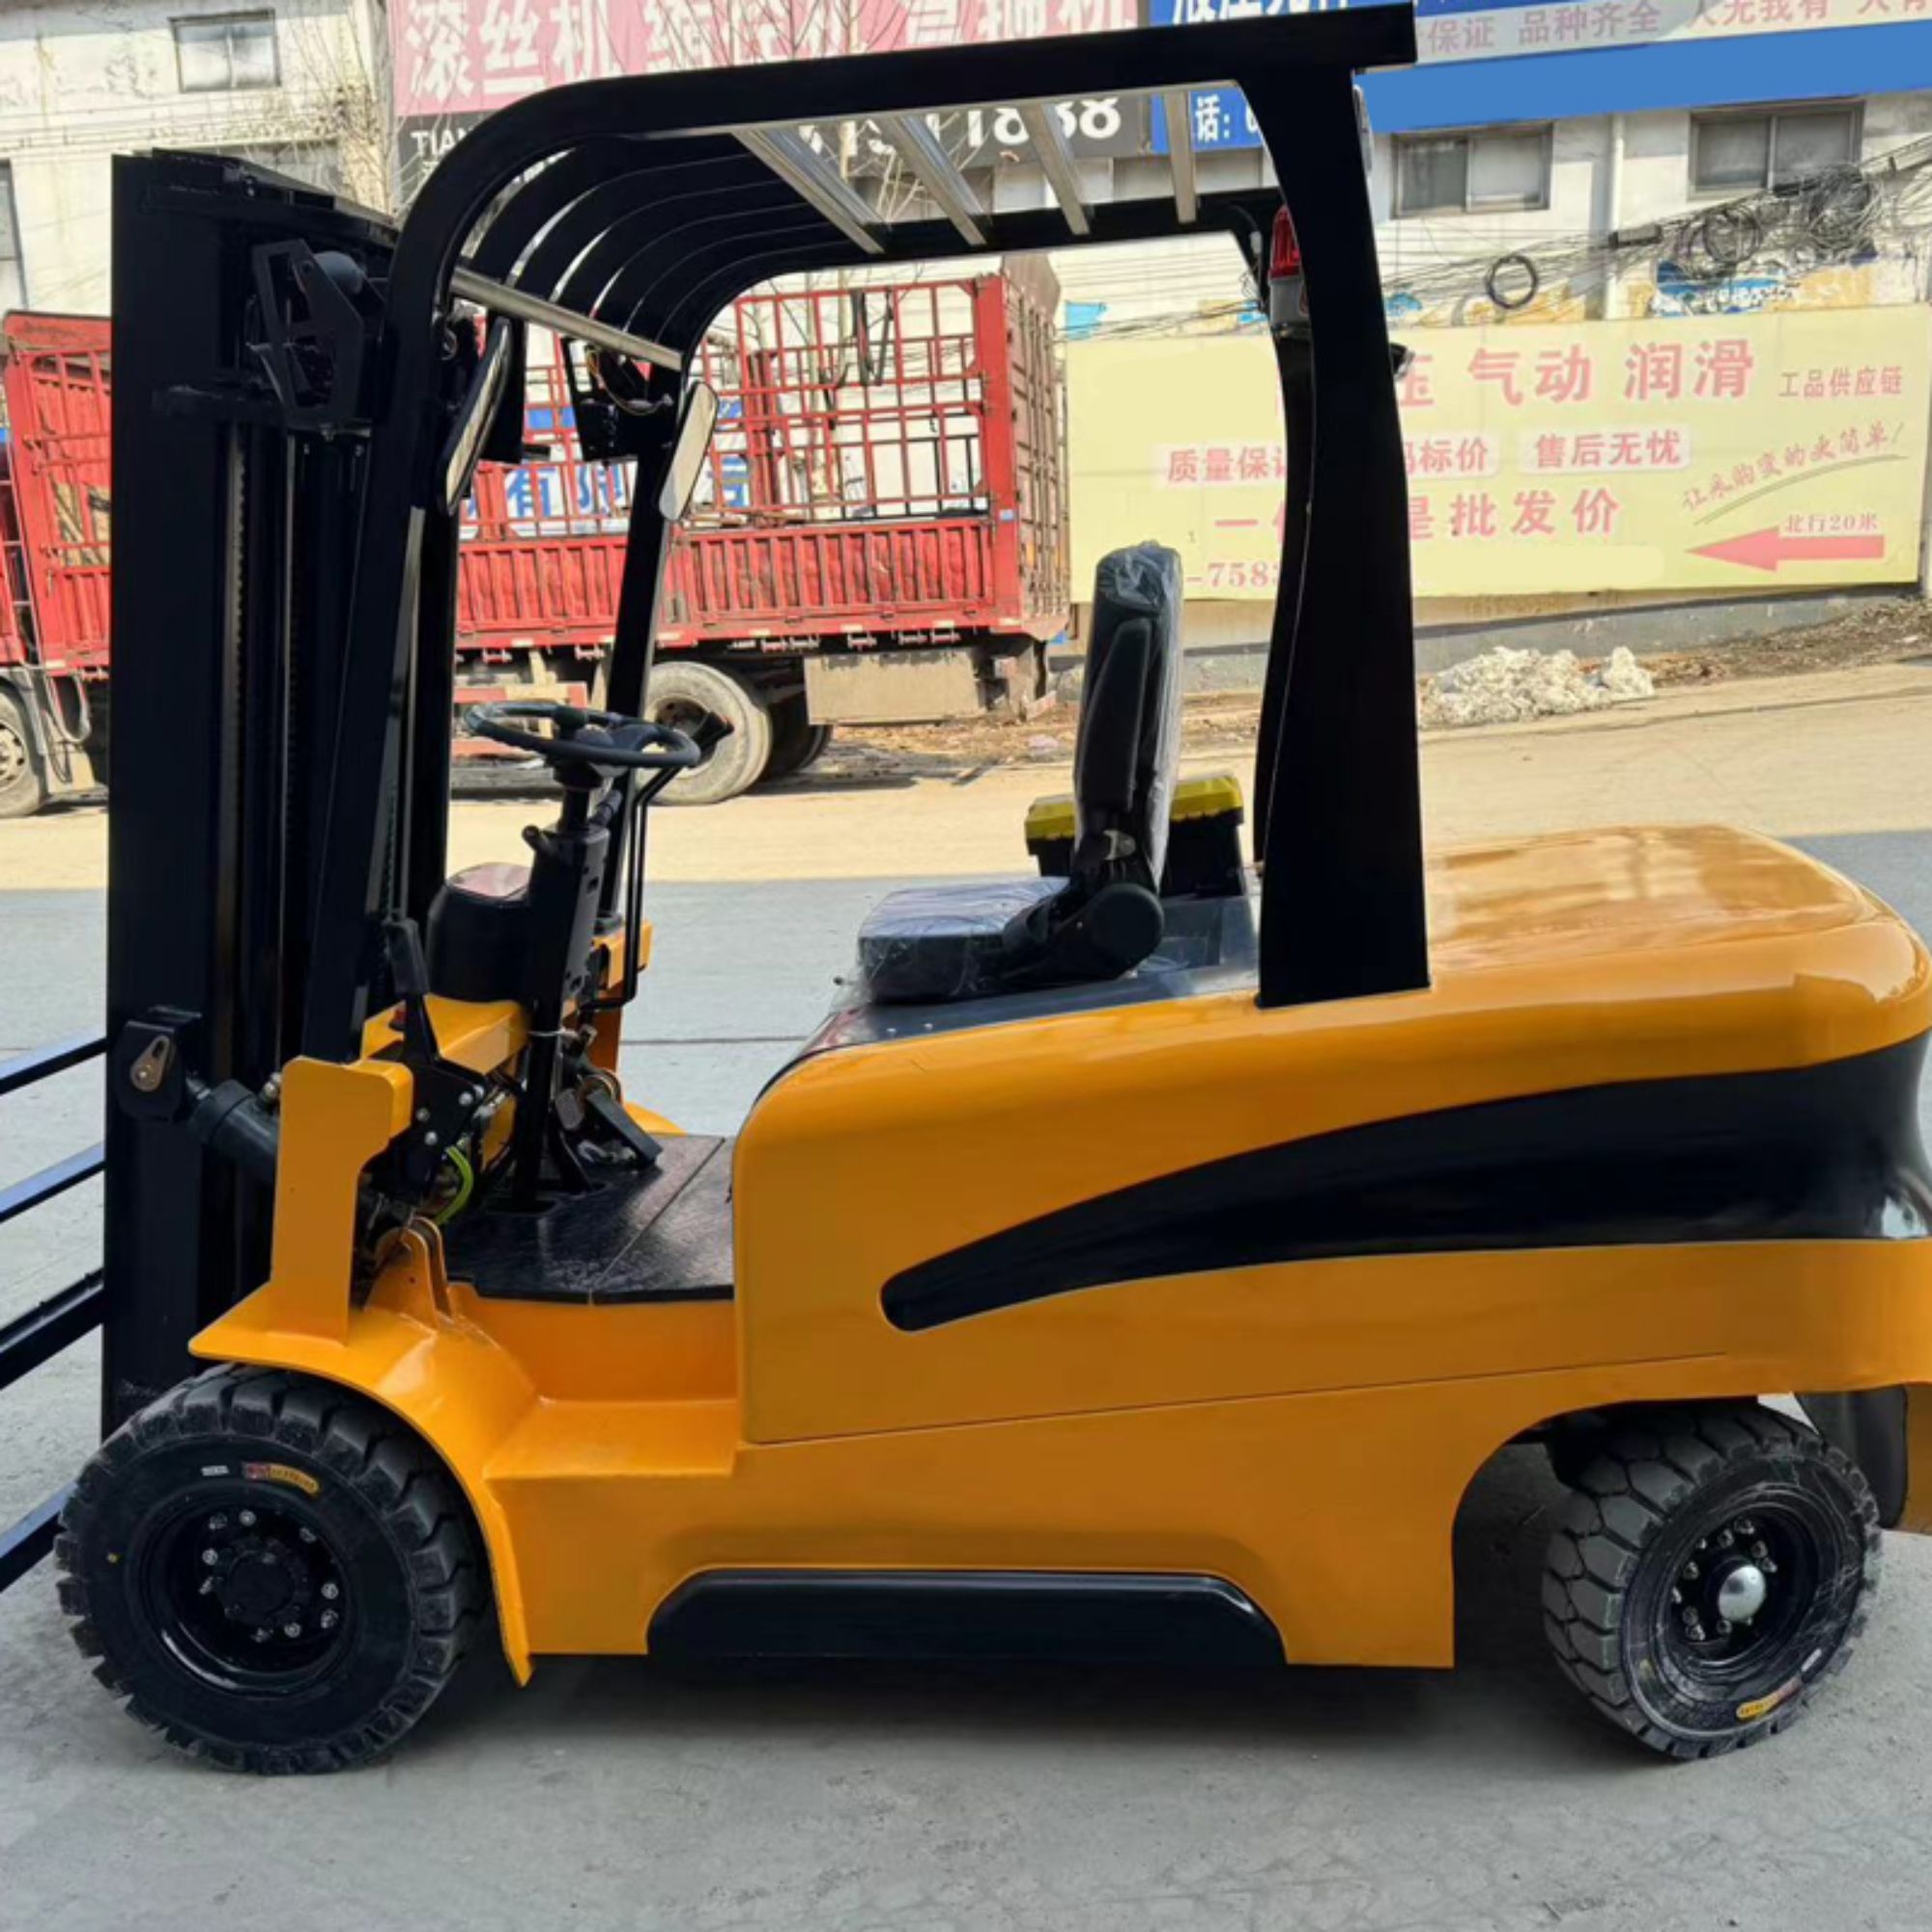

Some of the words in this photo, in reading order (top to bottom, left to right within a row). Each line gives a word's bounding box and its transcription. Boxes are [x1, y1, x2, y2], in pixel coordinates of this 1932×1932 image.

[1418, 15, 1496, 54] 保证
[1517, 2, 1662, 45] 品种齐全
[1467, 345, 1592, 407] 气动
[1624, 339, 1754, 400] 润滑
[1778, 366, 1903, 398] 工品供应链
[1536, 430, 1682, 469] 售后无忧
[1185, 560, 1278, 588] -758
